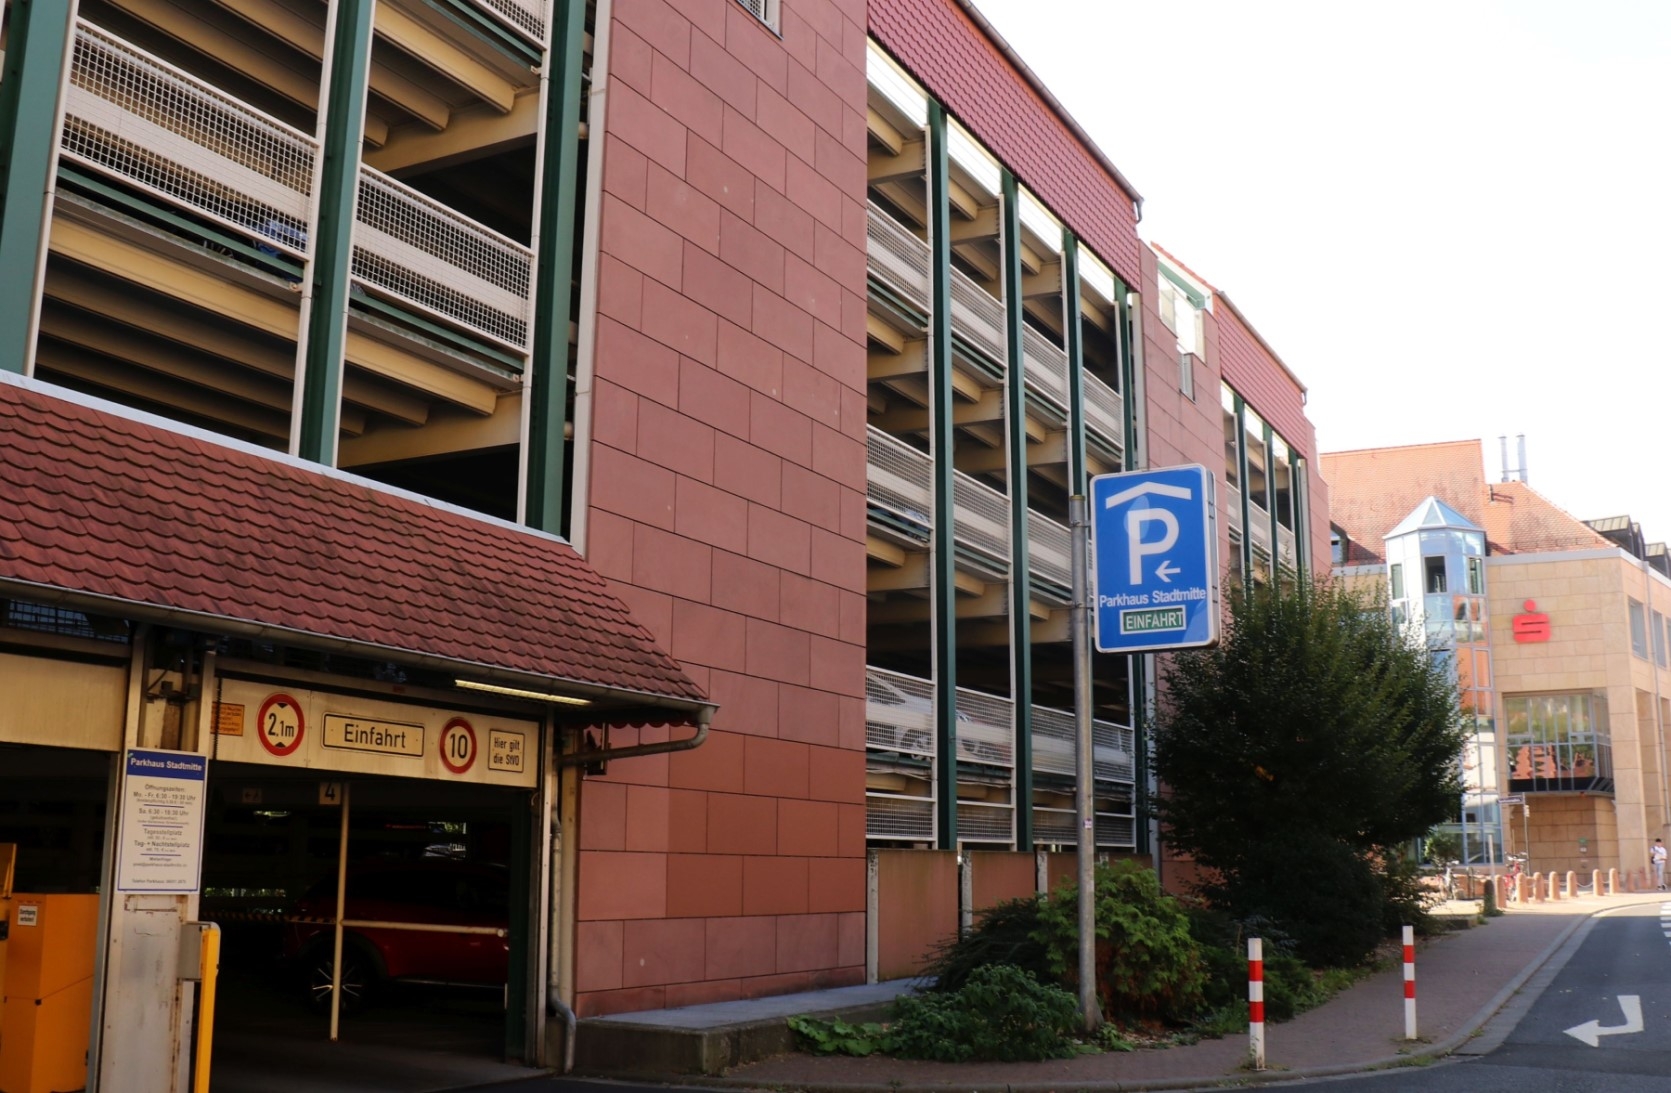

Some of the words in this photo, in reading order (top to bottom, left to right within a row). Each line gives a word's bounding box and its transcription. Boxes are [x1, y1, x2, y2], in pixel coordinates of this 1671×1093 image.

[1127, 507, 1180, 585] P
[1099, 593, 1149, 608] Parkhaus
[1152, 586, 1207, 604] Stadtmitte
[1125, 611, 1183, 630] EINFAHRT
[344, 723, 406, 749] Einfahrt
[494, 737, 507, 749] Hier
[509, 739, 520, 752] gilt
[450, 733, 468, 759] 10
[130, 758, 165, 768] Parkhaus
[166, 761, 202, 771] Stadtmitte
[493, 752, 503, 764] die
[505, 754, 520, 766] StVO
[324, 783, 336, 800] 4
